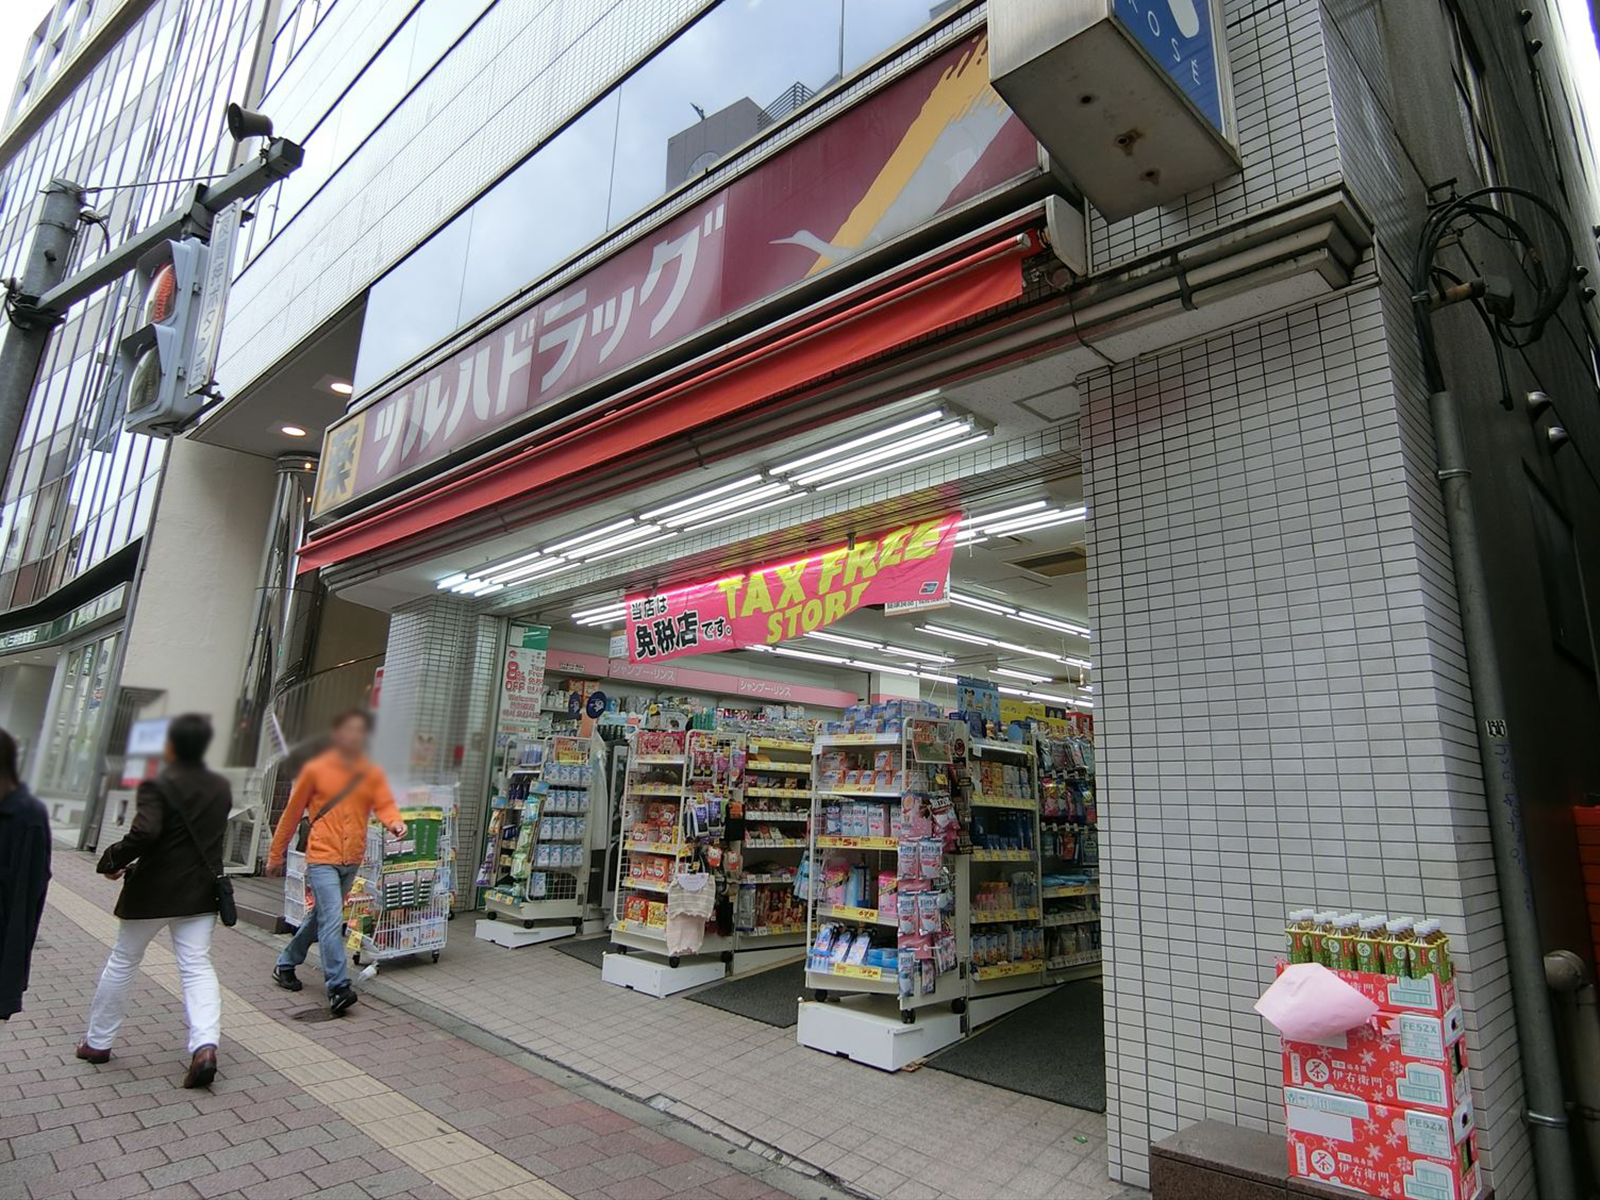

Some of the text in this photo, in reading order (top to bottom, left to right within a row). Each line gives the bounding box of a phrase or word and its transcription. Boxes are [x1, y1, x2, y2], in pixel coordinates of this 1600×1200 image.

[372, 203, 725, 475] ツルハドラッグ
[718, 518, 947, 619] TAX FREE
[631, 596, 668, 621] 当店は
[635, 610, 732, 659] 免税店です。
[1333, 1069, 1383, 1089] 伊右衛門
[1338, 1162, 1389, 1184] 伊右衛門
